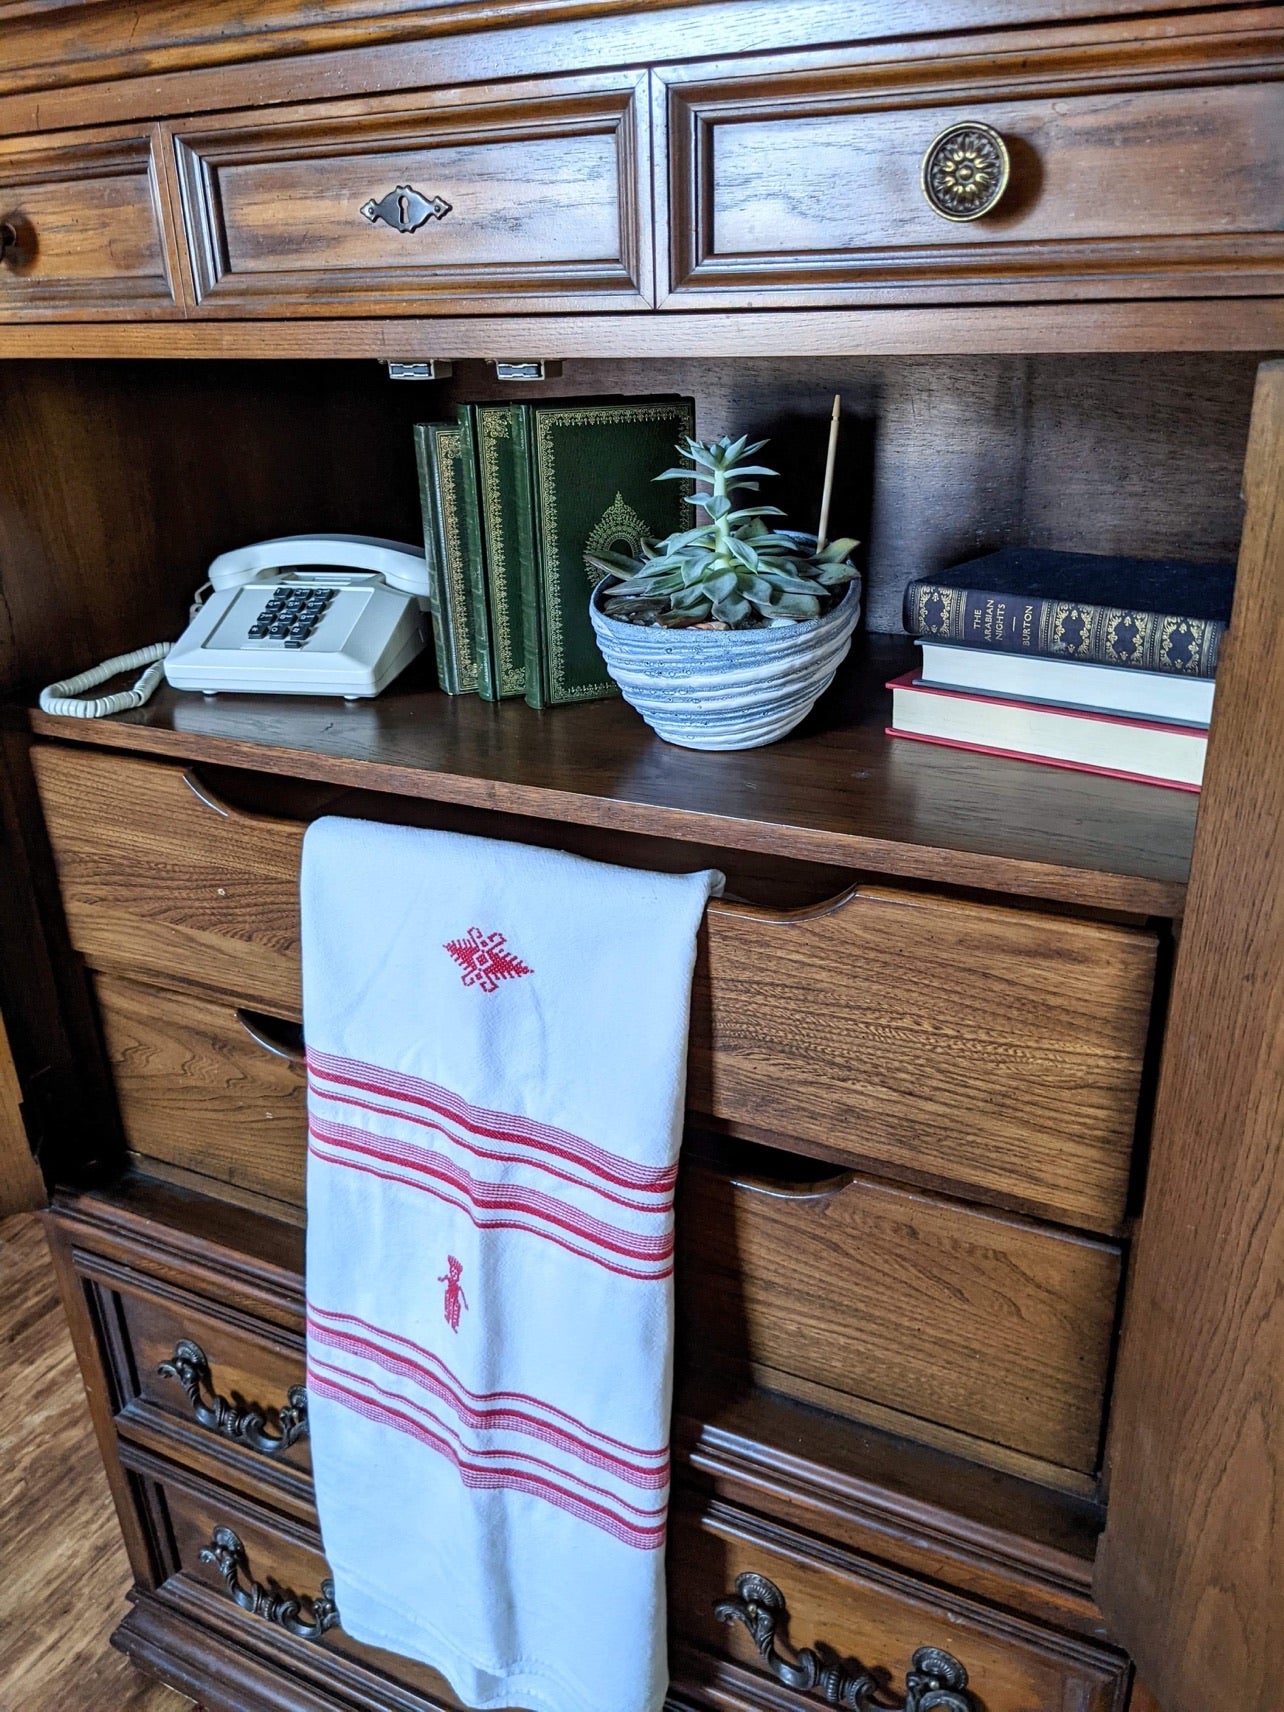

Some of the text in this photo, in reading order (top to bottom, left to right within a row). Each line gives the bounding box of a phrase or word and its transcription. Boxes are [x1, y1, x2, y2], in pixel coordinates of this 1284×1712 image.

[973, 609, 982, 629] THE
[984, 599, 995, 642] ARABIAN
[995, 603, 1006, 640] NIGHTS
[1022, 605, 1034, 647] BURTON
